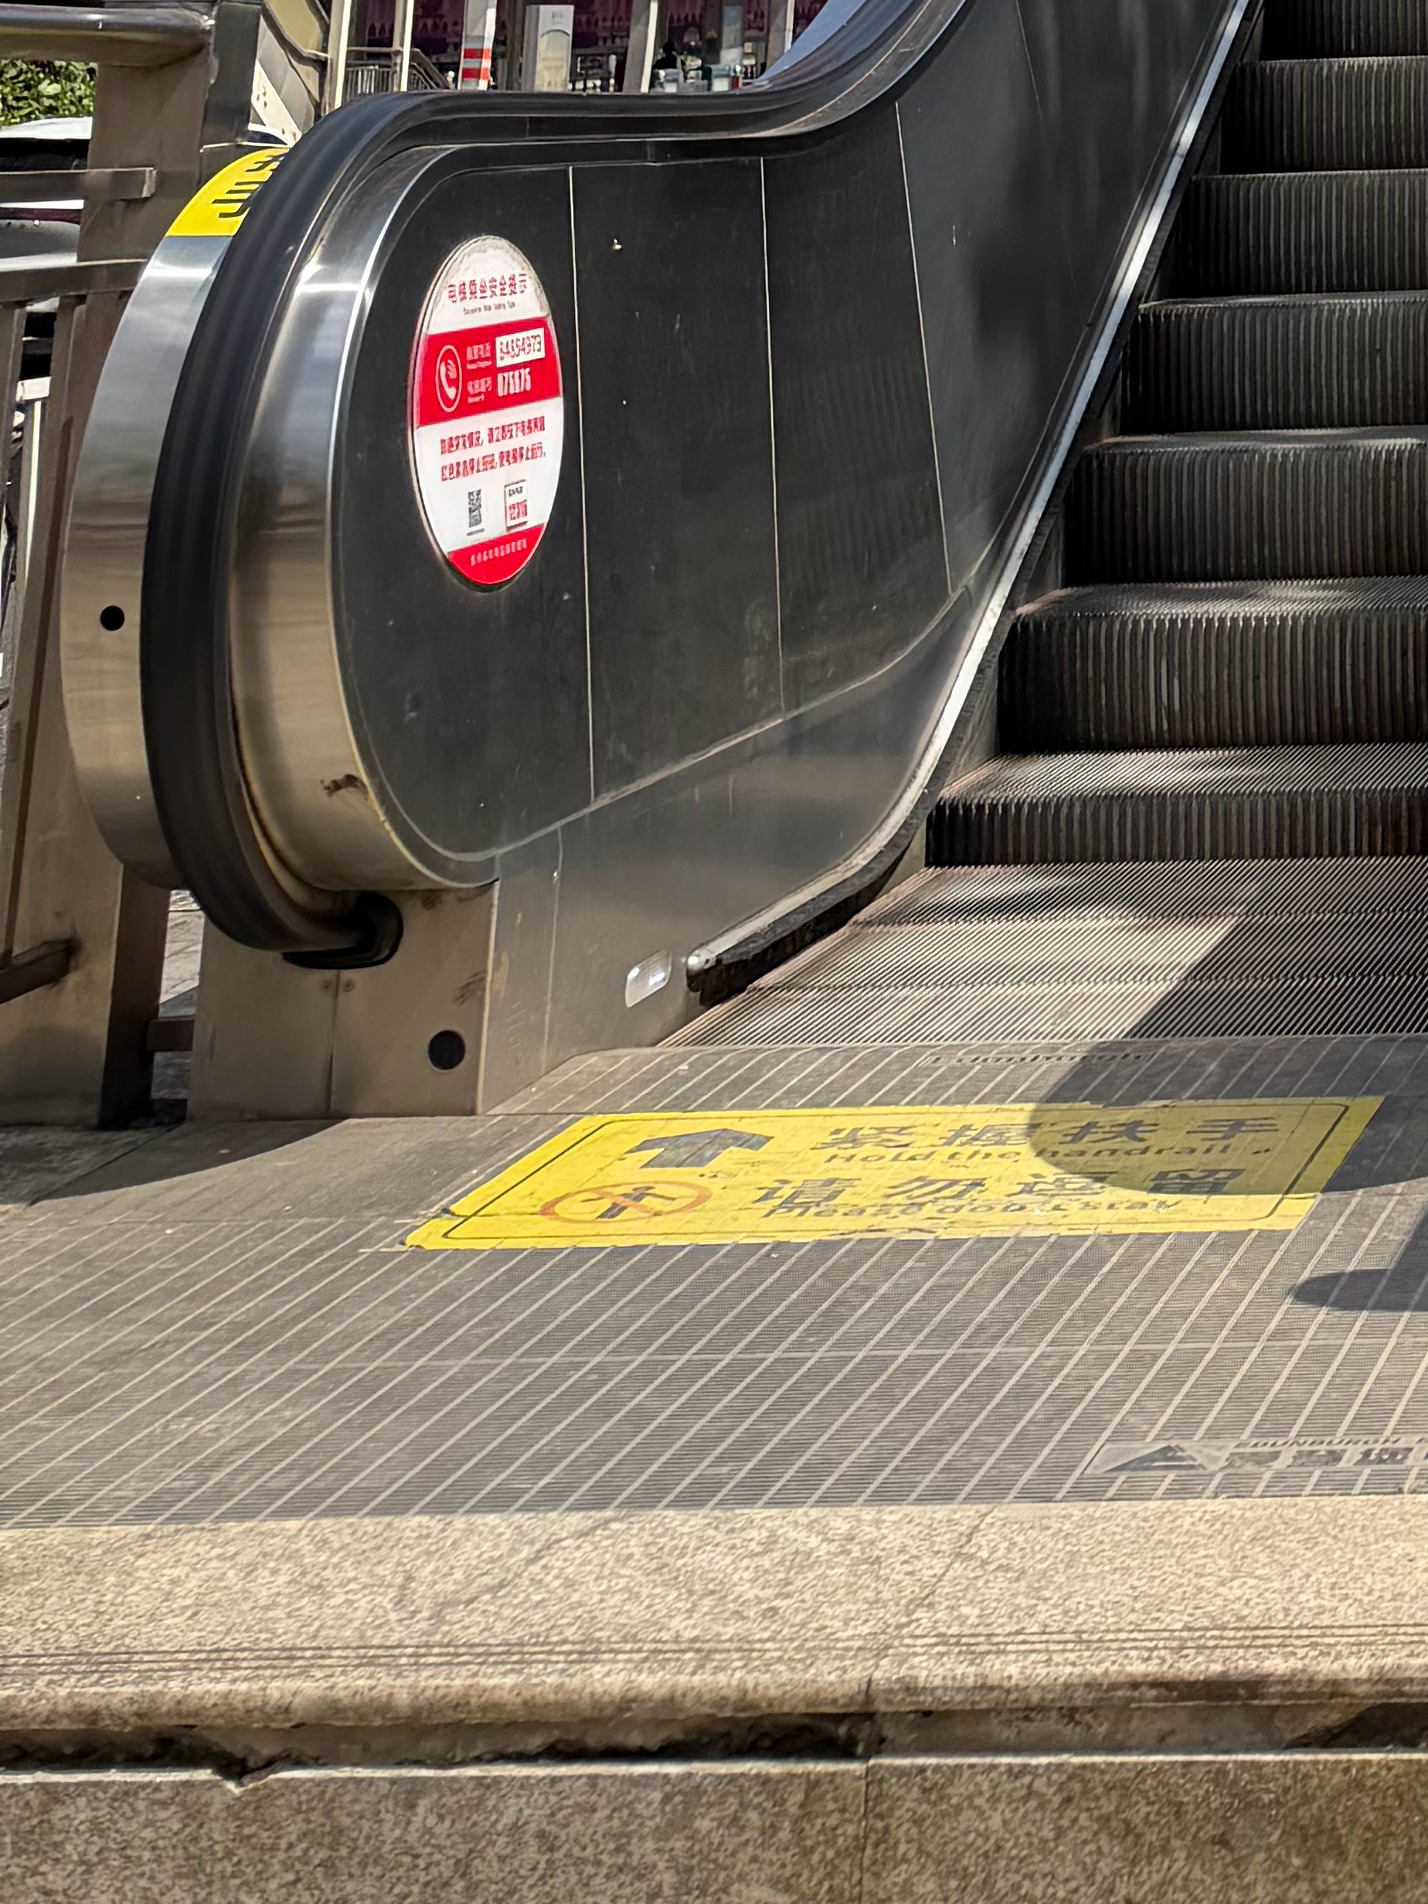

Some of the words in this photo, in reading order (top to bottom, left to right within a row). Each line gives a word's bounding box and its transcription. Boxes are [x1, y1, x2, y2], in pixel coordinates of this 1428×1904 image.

[810, 1117, 1279, 1150] 紧握扶手
[824, 1149, 937, 1164] Hold
[947, 1149, 1021, 1161] the
[1034, 1143, 1231, 1158] handrail
[752, 1168, 1246, 1206] 请勿逗留
[937, 1200, 1070, 1214] dont
